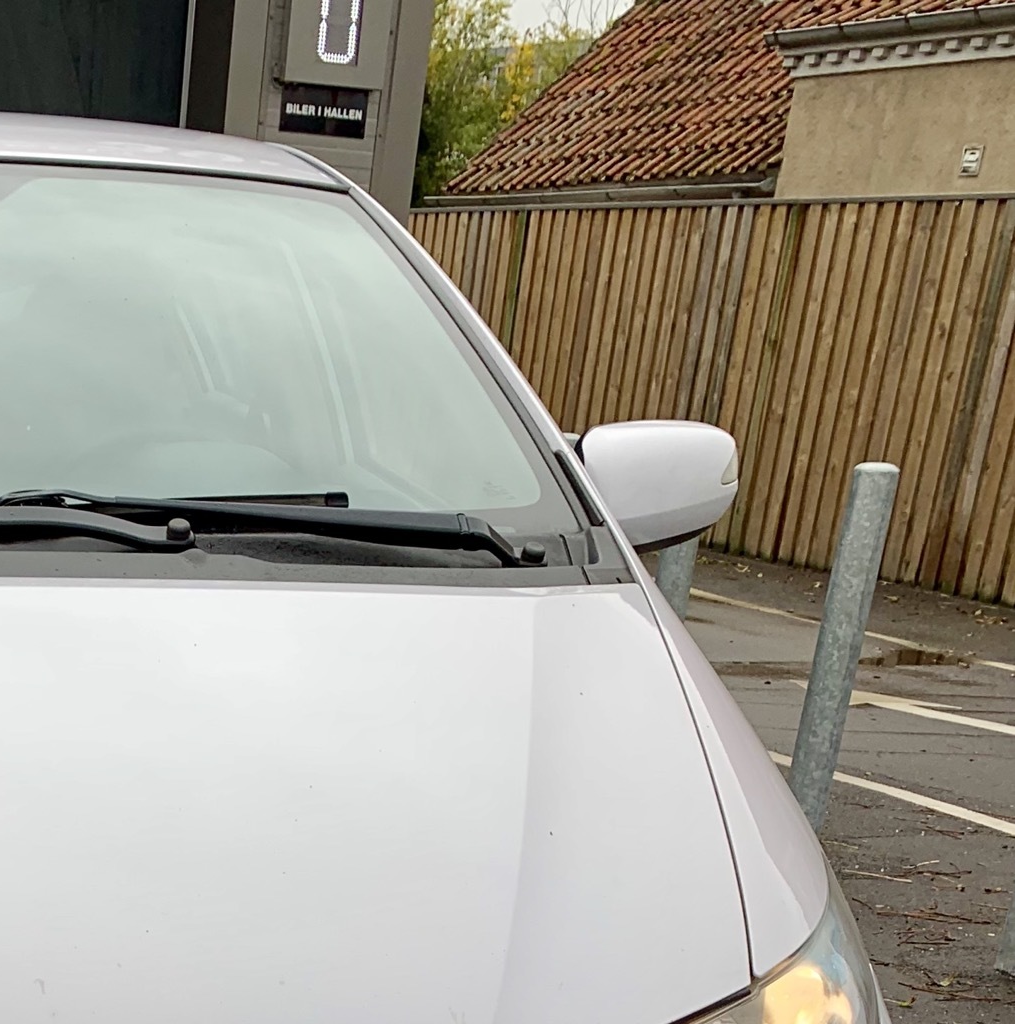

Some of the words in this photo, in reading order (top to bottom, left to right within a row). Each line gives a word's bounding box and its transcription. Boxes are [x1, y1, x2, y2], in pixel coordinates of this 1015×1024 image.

[286, 103, 315, 116] BILER
[317, 105, 322, 117] I
[324, 106, 362, 120] HALLEN
